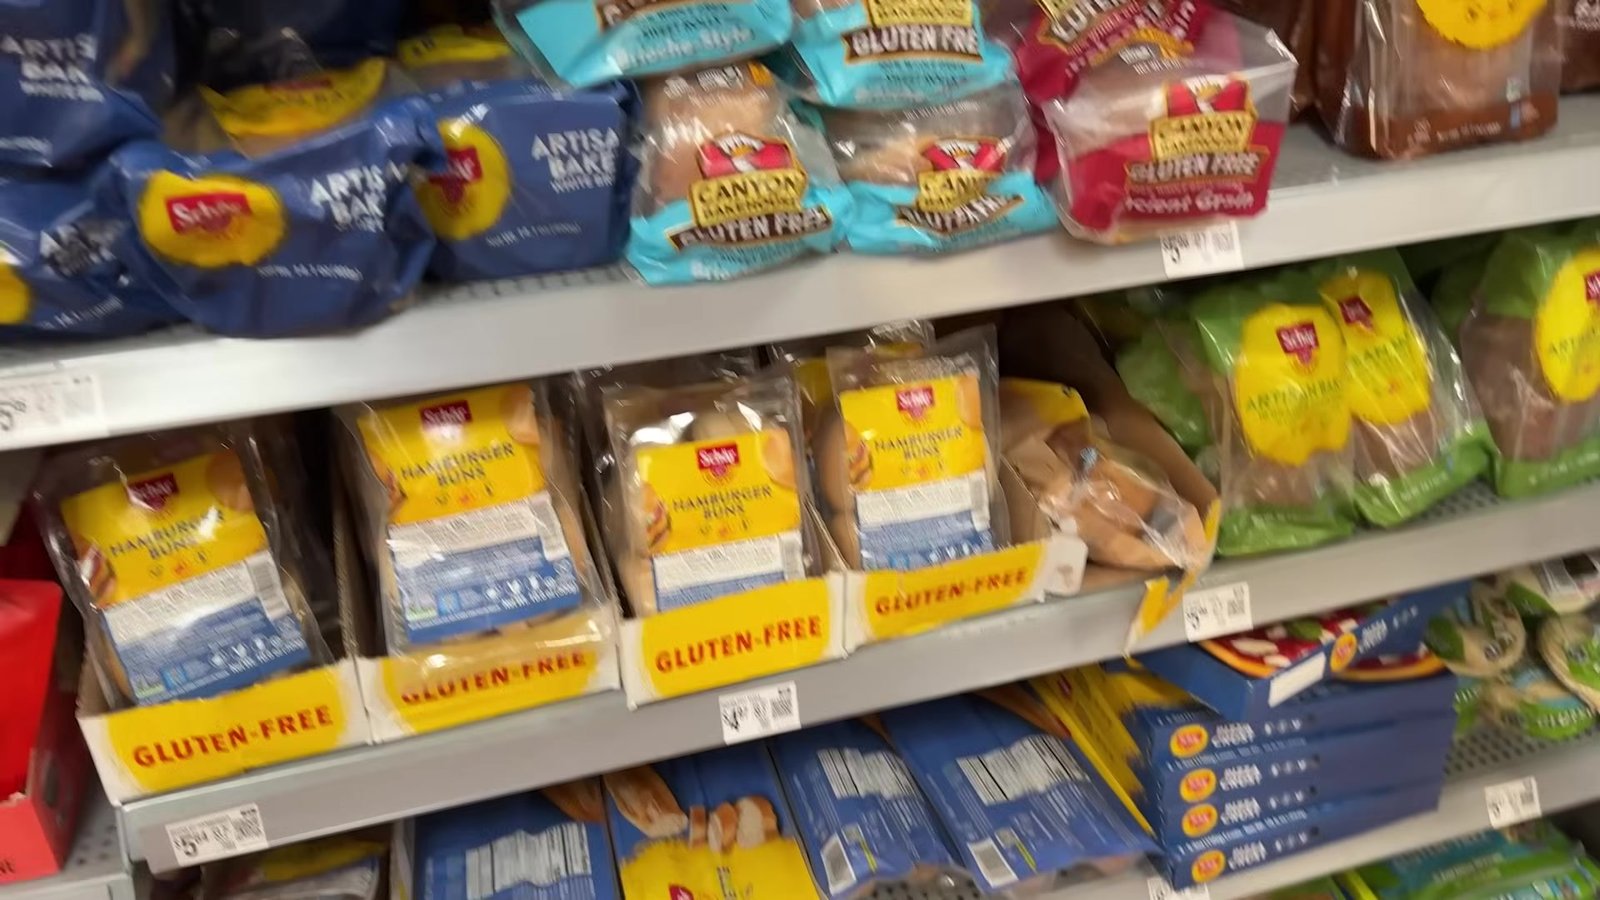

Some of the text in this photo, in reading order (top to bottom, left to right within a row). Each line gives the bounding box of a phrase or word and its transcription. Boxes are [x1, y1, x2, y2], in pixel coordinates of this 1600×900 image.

[852, 24, 937, 56] GLUTEN
[1129, 151, 1260, 182] GLUTEN FREE
[698, 174, 797, 204] CANYON
[1194, 188, 1255, 212] Grain
[874, 426, 963, 451] HAMBURGER
[904, 445, 941, 462] BUNS
[400, 441, 516, 481] HAMBURGER
[436, 466, 488, 488] BUNS
[671, 484, 774, 514] HAMBURGER
[703, 502, 747, 521] BUNS
[109, 508, 226, 558] HAMBURGR
[874, 568, 1028, 617] GLUTEN-FREE
[655, 614, 823, 675] GLUTEN-FREE
[401, 650, 588, 707] GLUTEN-FREE
[133, 703, 335, 770] GLUTEN-FREE
